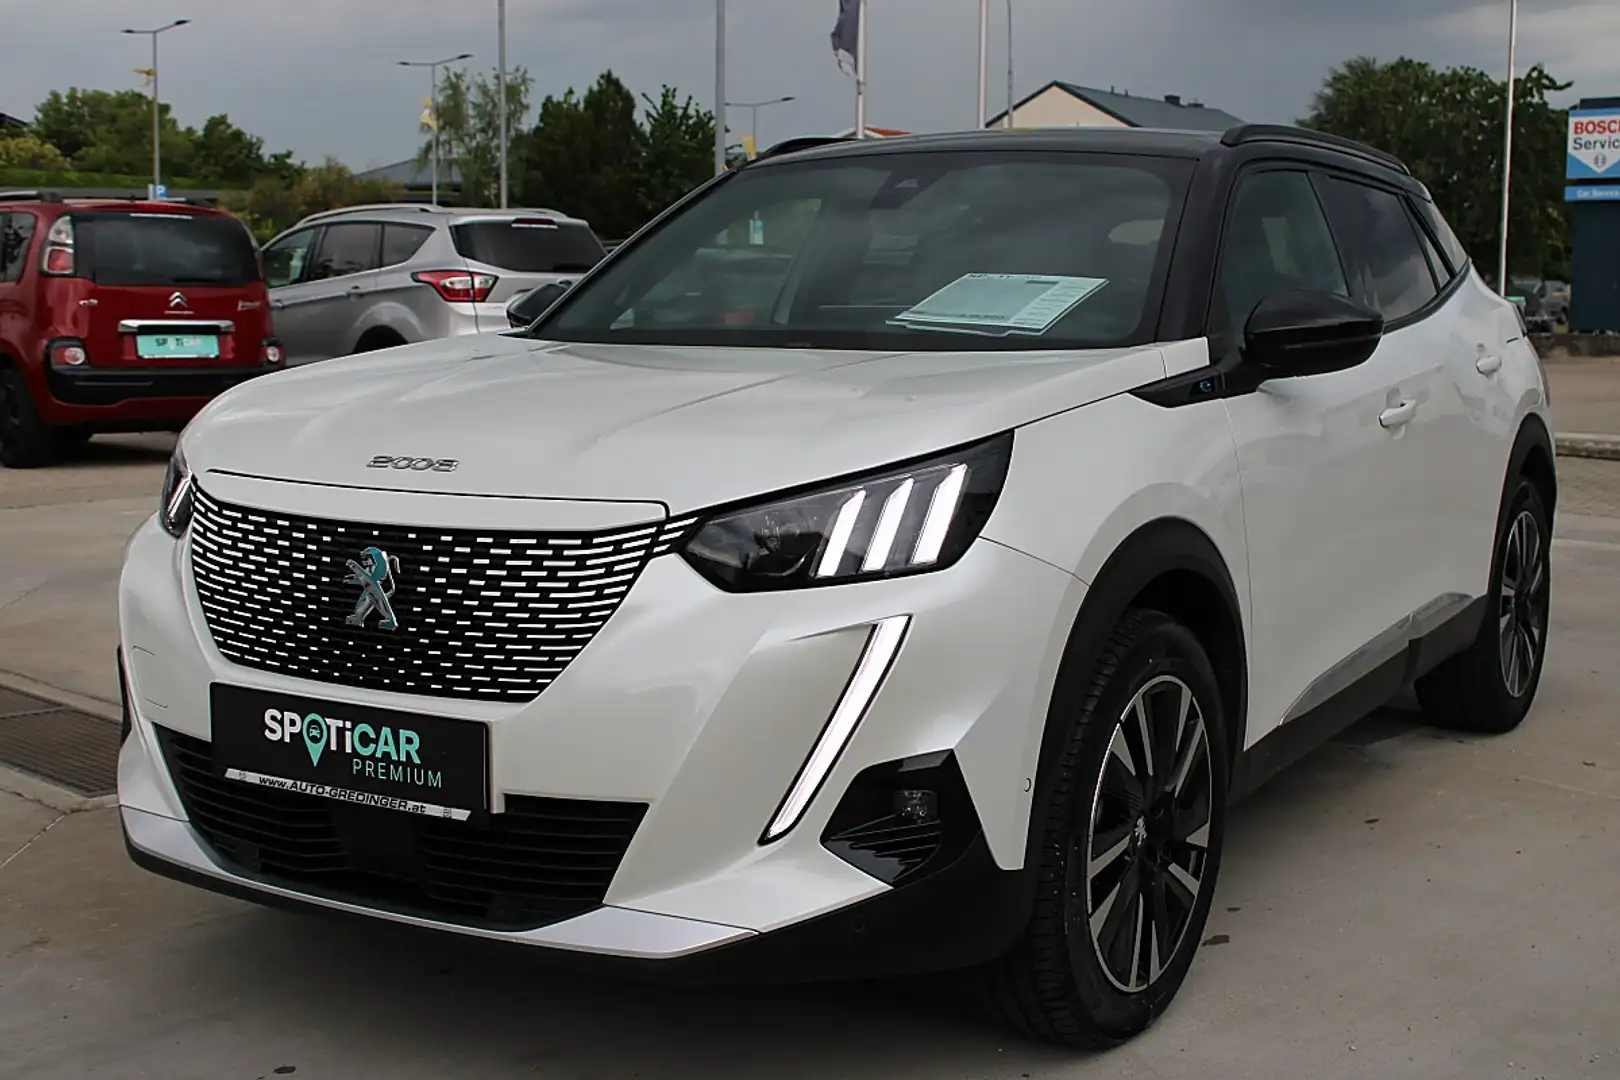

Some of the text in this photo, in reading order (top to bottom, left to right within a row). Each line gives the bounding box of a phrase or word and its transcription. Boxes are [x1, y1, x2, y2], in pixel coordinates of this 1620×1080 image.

[1573, 120, 1620, 135] BOSC
[366, 455, 460, 472] 2008
[352, 758, 442, 788] PREMIUM
[258, 775, 427, 814] www.AUTO-GREDINGER.at
